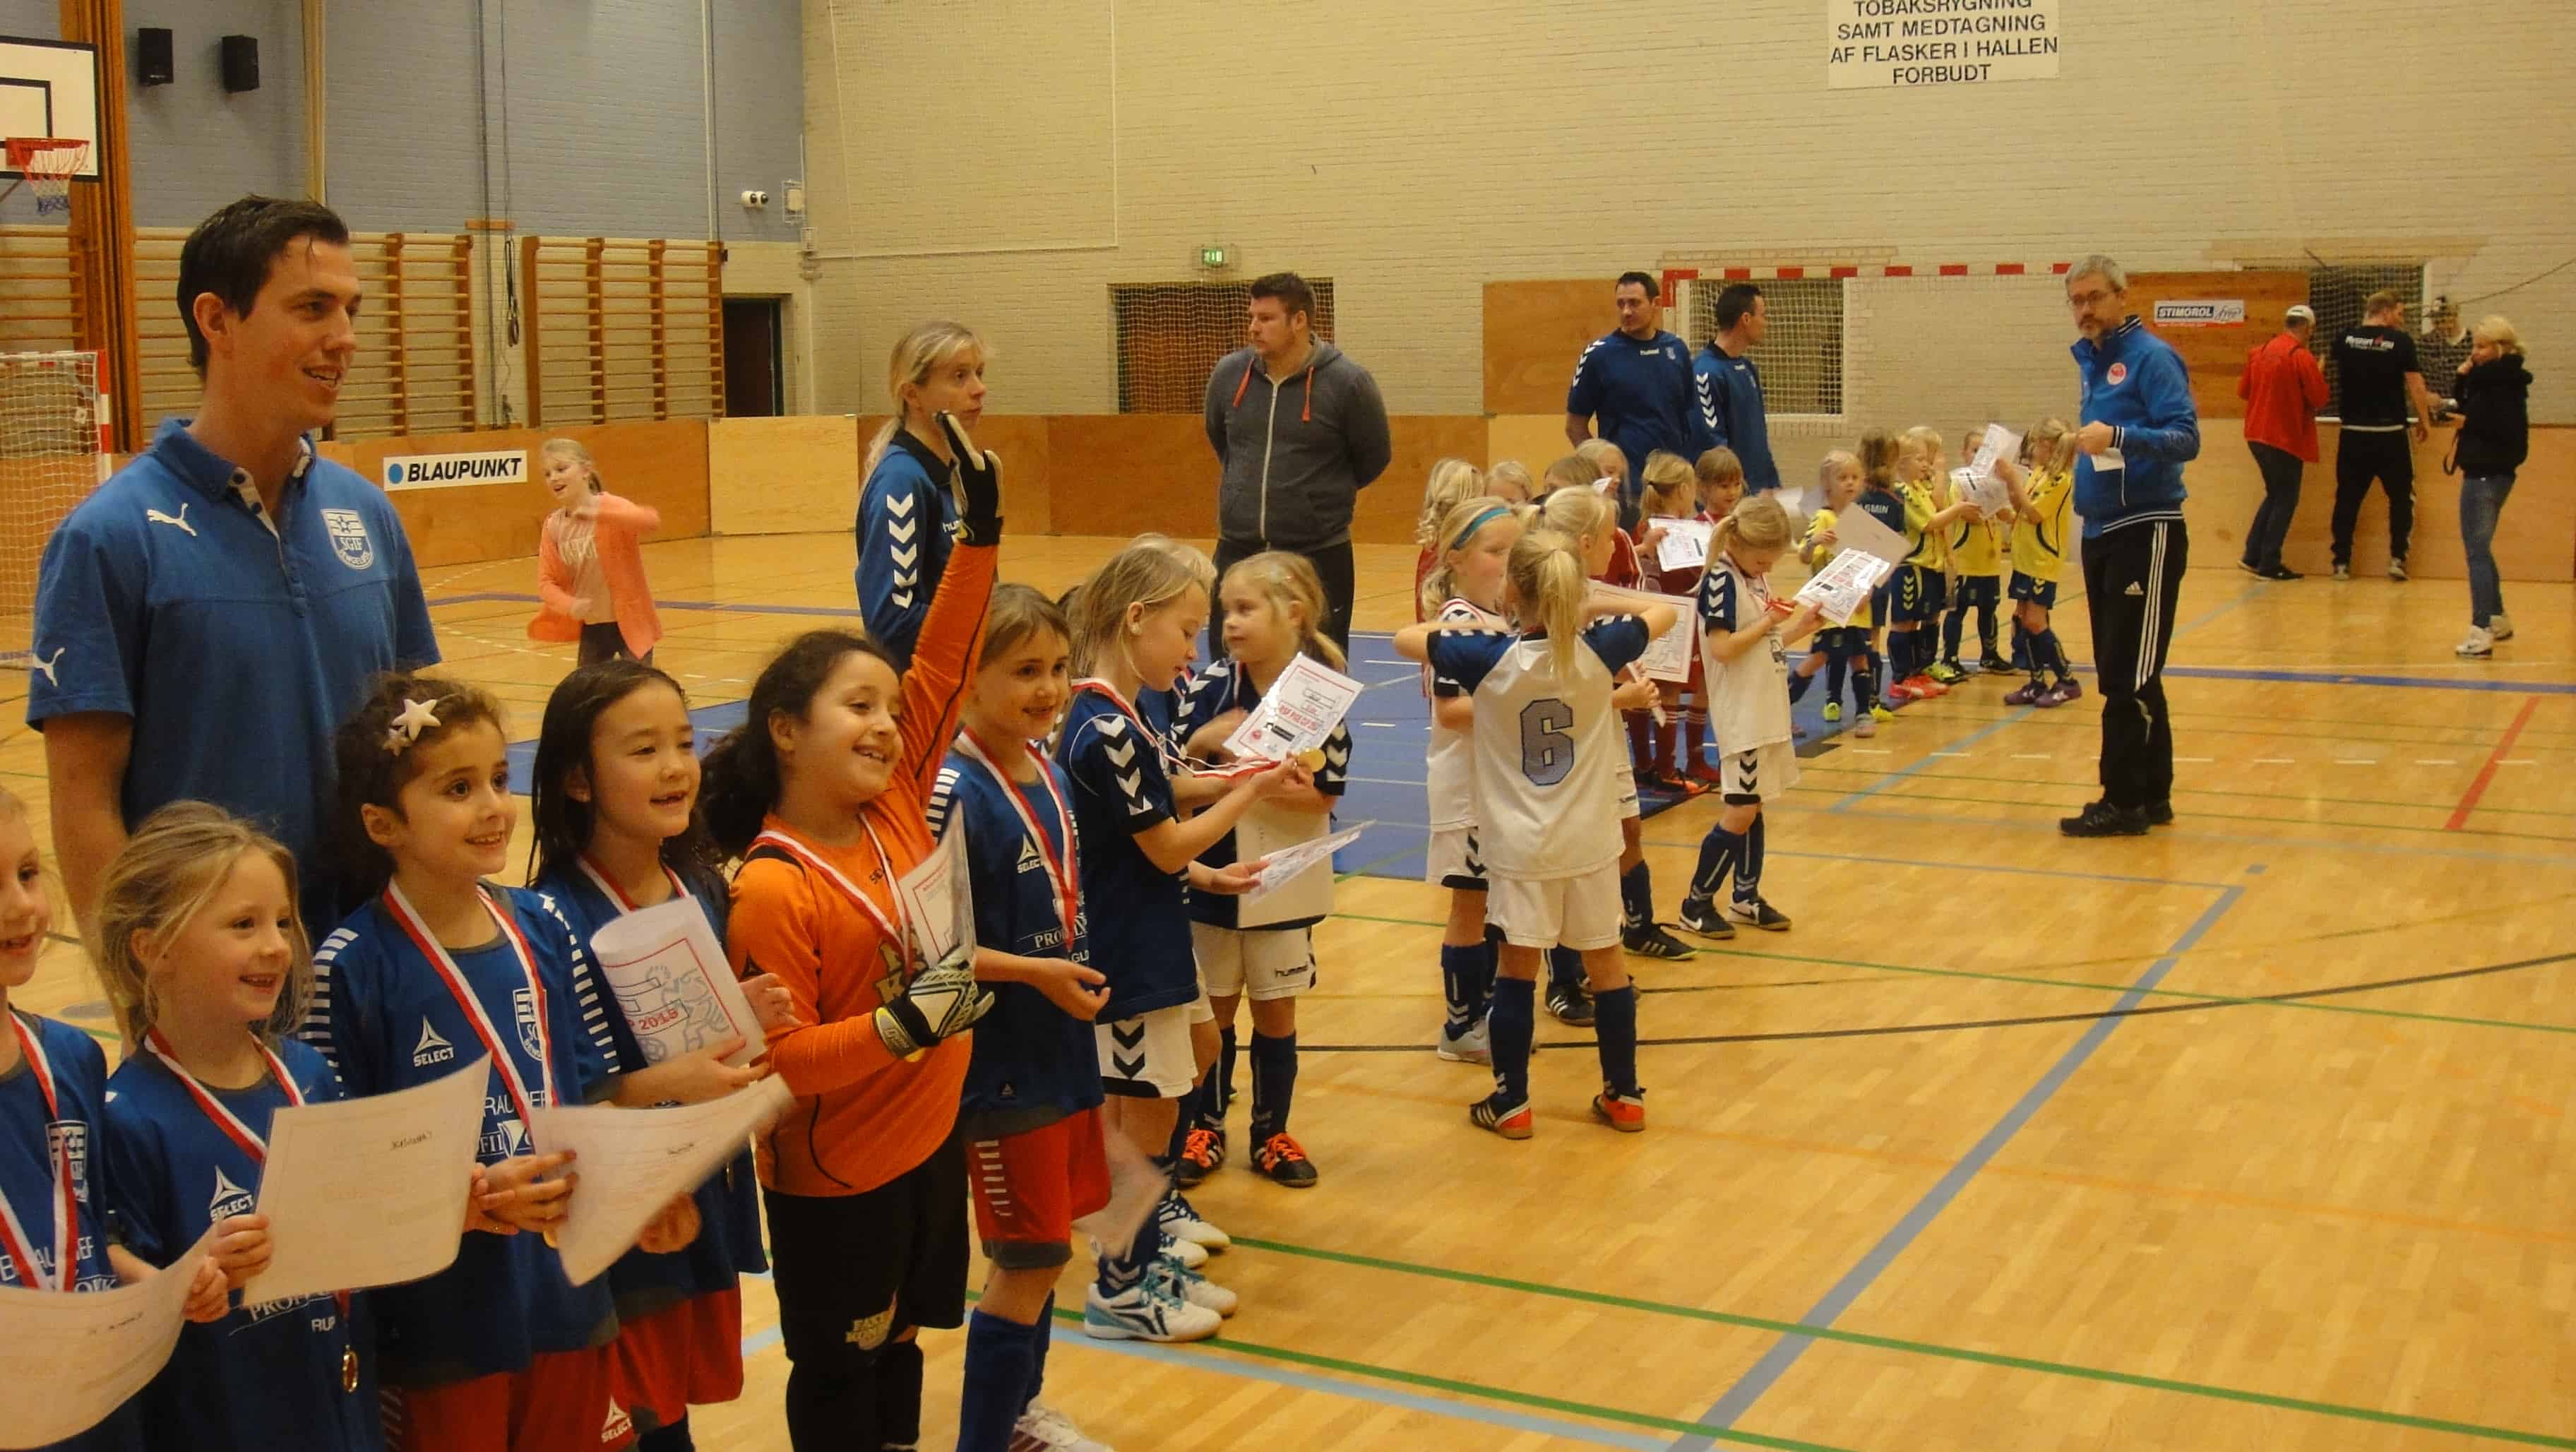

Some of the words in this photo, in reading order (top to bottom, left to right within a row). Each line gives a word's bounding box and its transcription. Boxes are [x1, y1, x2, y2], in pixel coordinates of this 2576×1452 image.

[1837, 21, 1894, 40] SAMT
[1902, 14, 2046, 37] MEDTAGNING
[1830, 47, 1855, 64] AF
[1863, 41, 1957, 62] FLASKER
[1963, 41, 1968, 57] I
[1976, 37, 2058, 57] HALLEN
[1892, 64, 1991, 84] FORBUDT
[2158, 307, 2212, 317] STIMOROL
[407, 458, 522, 482] BLAUPUNKT
[1520, 698, 1574, 786] 6
[1017, 857, 1043, 874] SELEC
[639, 1008, 679, 1030] 2015
[413, 1047, 454, 1067] SELECT
